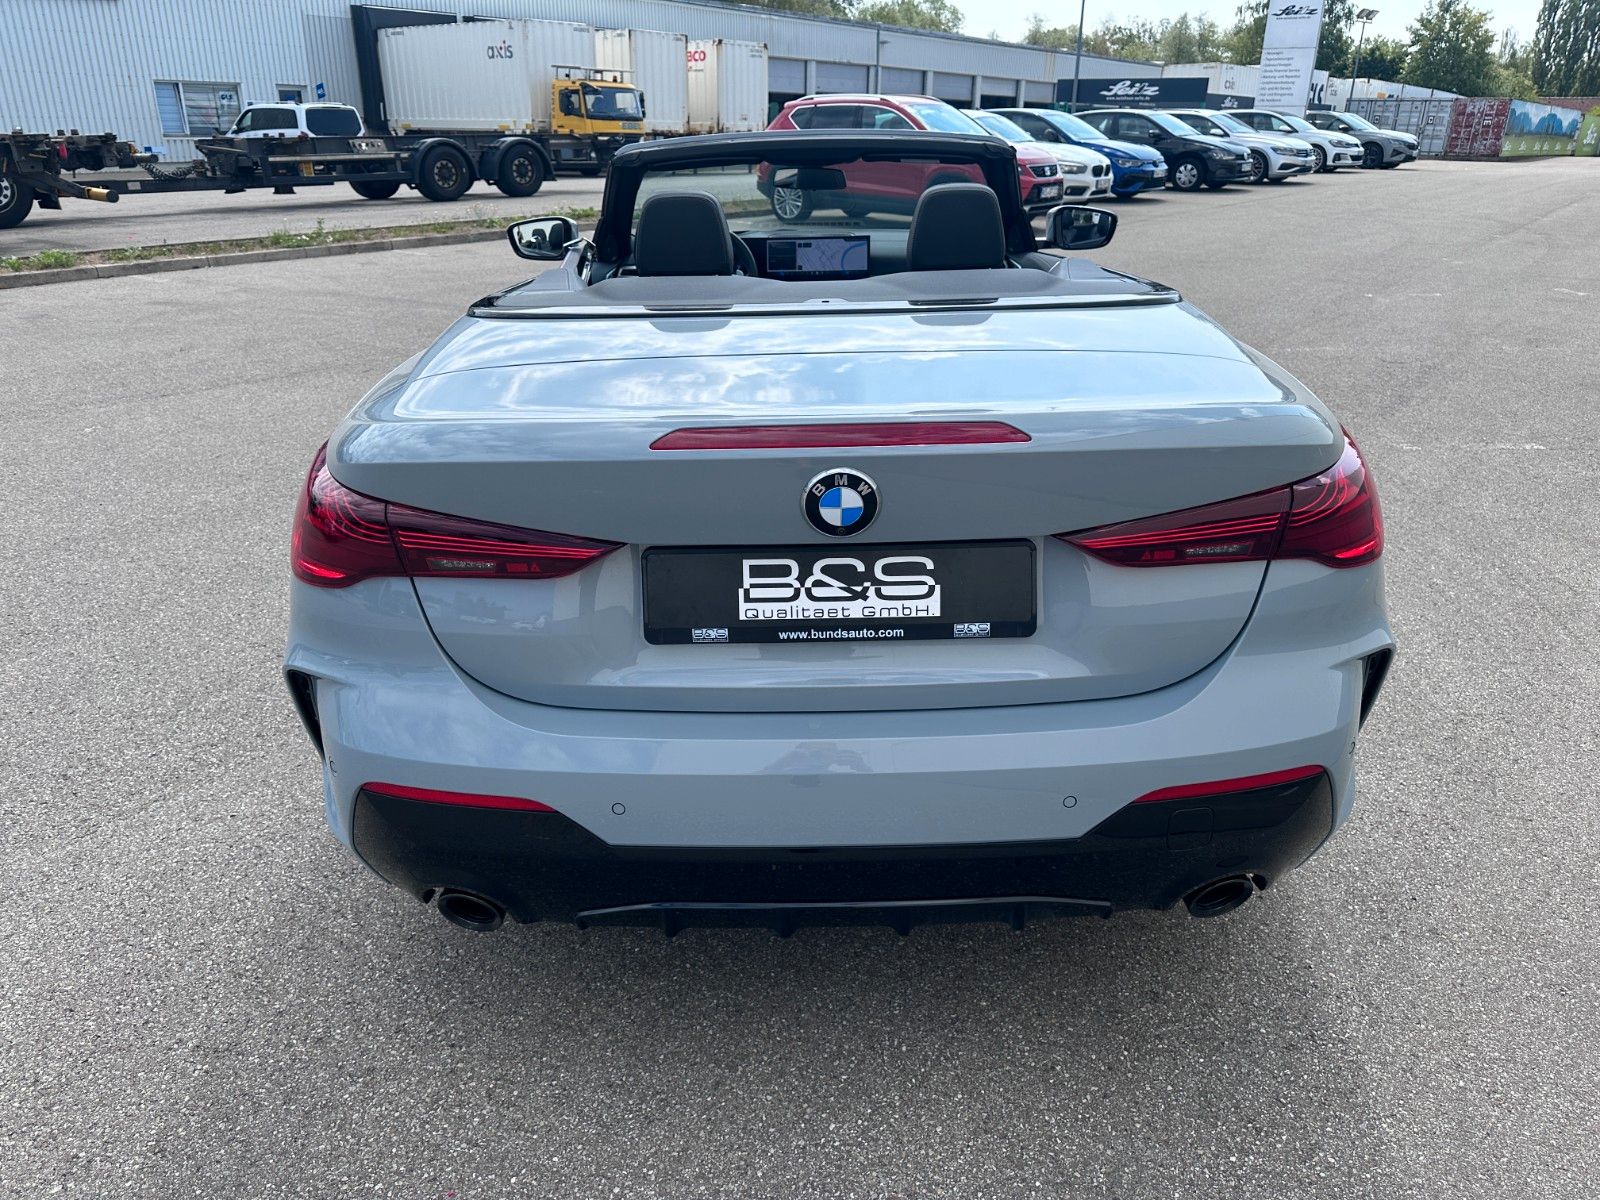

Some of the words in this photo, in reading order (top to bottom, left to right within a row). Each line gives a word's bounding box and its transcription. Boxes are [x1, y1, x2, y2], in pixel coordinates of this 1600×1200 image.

[487, 40, 513, 59] axis
[811, 474, 872, 497] BMW
[742, 556, 936, 603] B&S
[744, 605, 851, 619] Qualitaet
[862, 603, 936, 617] GmbH.
[778, 628, 904, 640] www.bundsauto.com
